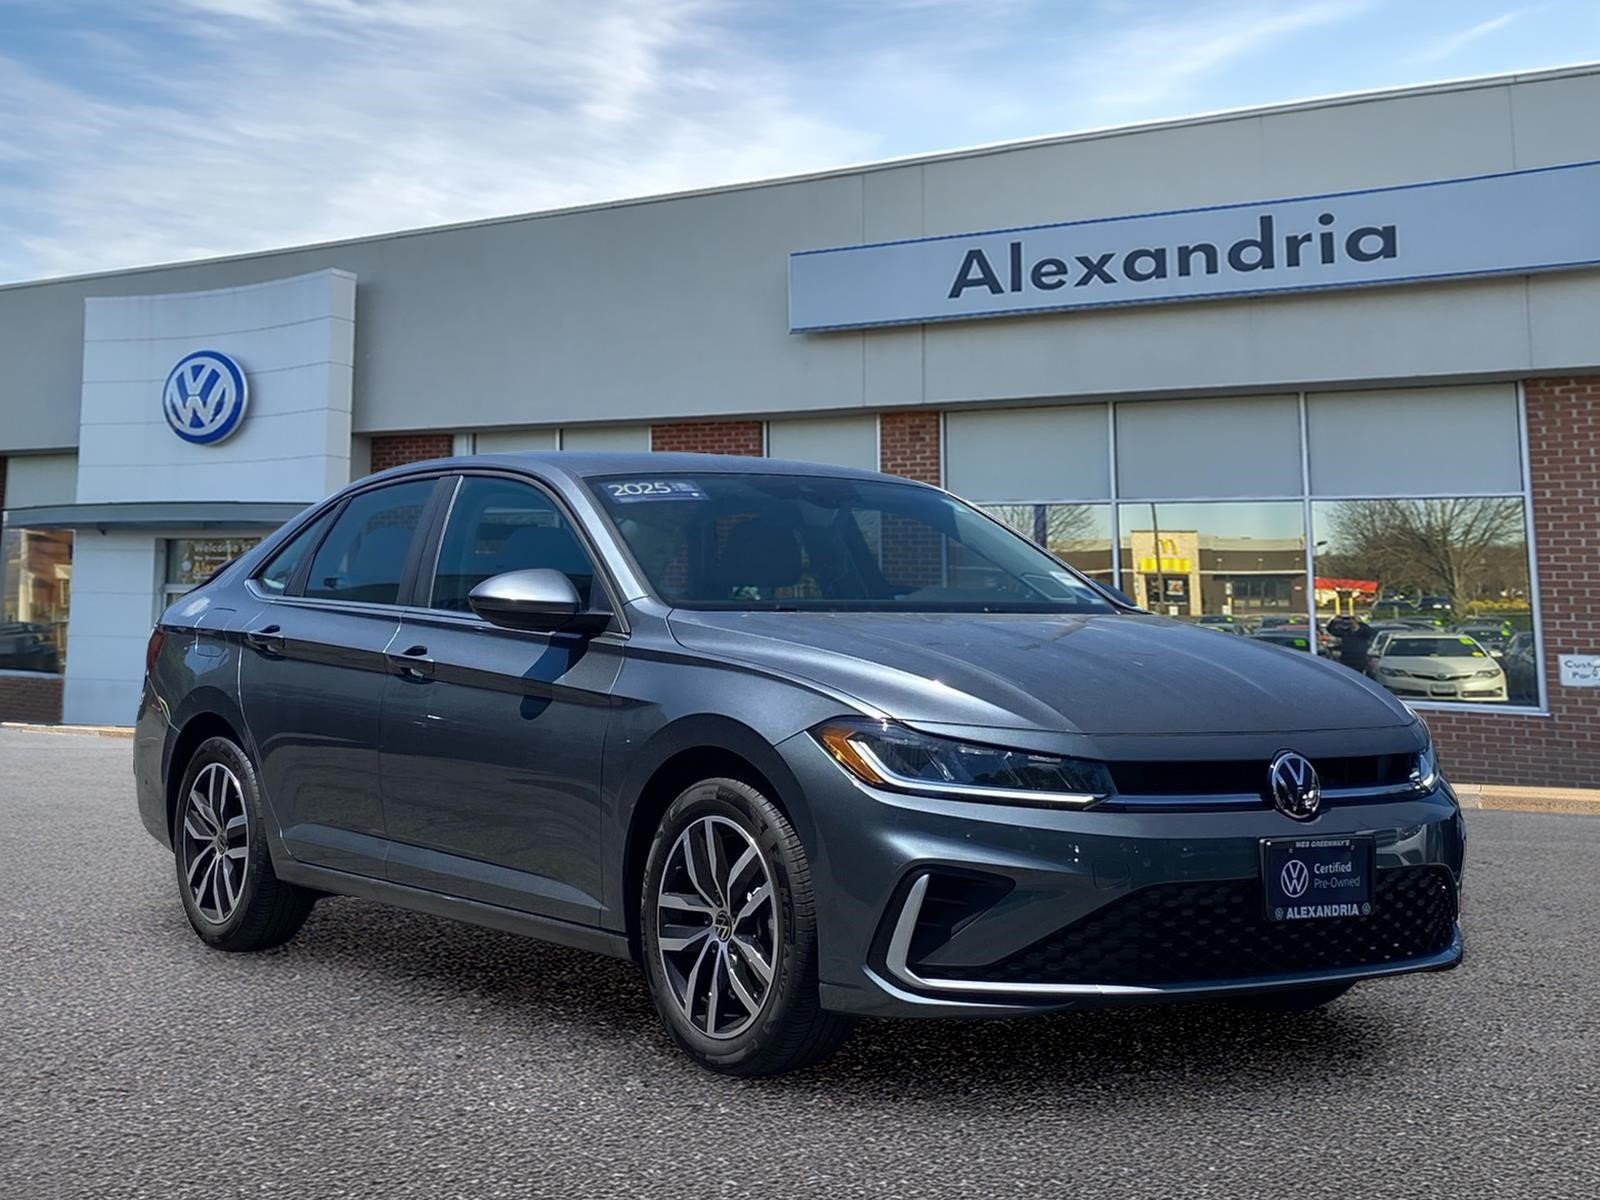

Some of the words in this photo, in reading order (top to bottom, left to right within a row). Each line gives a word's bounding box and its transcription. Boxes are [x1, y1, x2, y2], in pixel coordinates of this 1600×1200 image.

[947, 212, 1398, 299] Alexandria
[608, 482, 672, 497] 2025
[194, 543, 239, 553] Welcome
[1313, 861, 1352, 874] Certified
[1313, 876, 1361, 889] Pre-Owned
[1285, 903, 1360, 920] ALEXANDRIA
